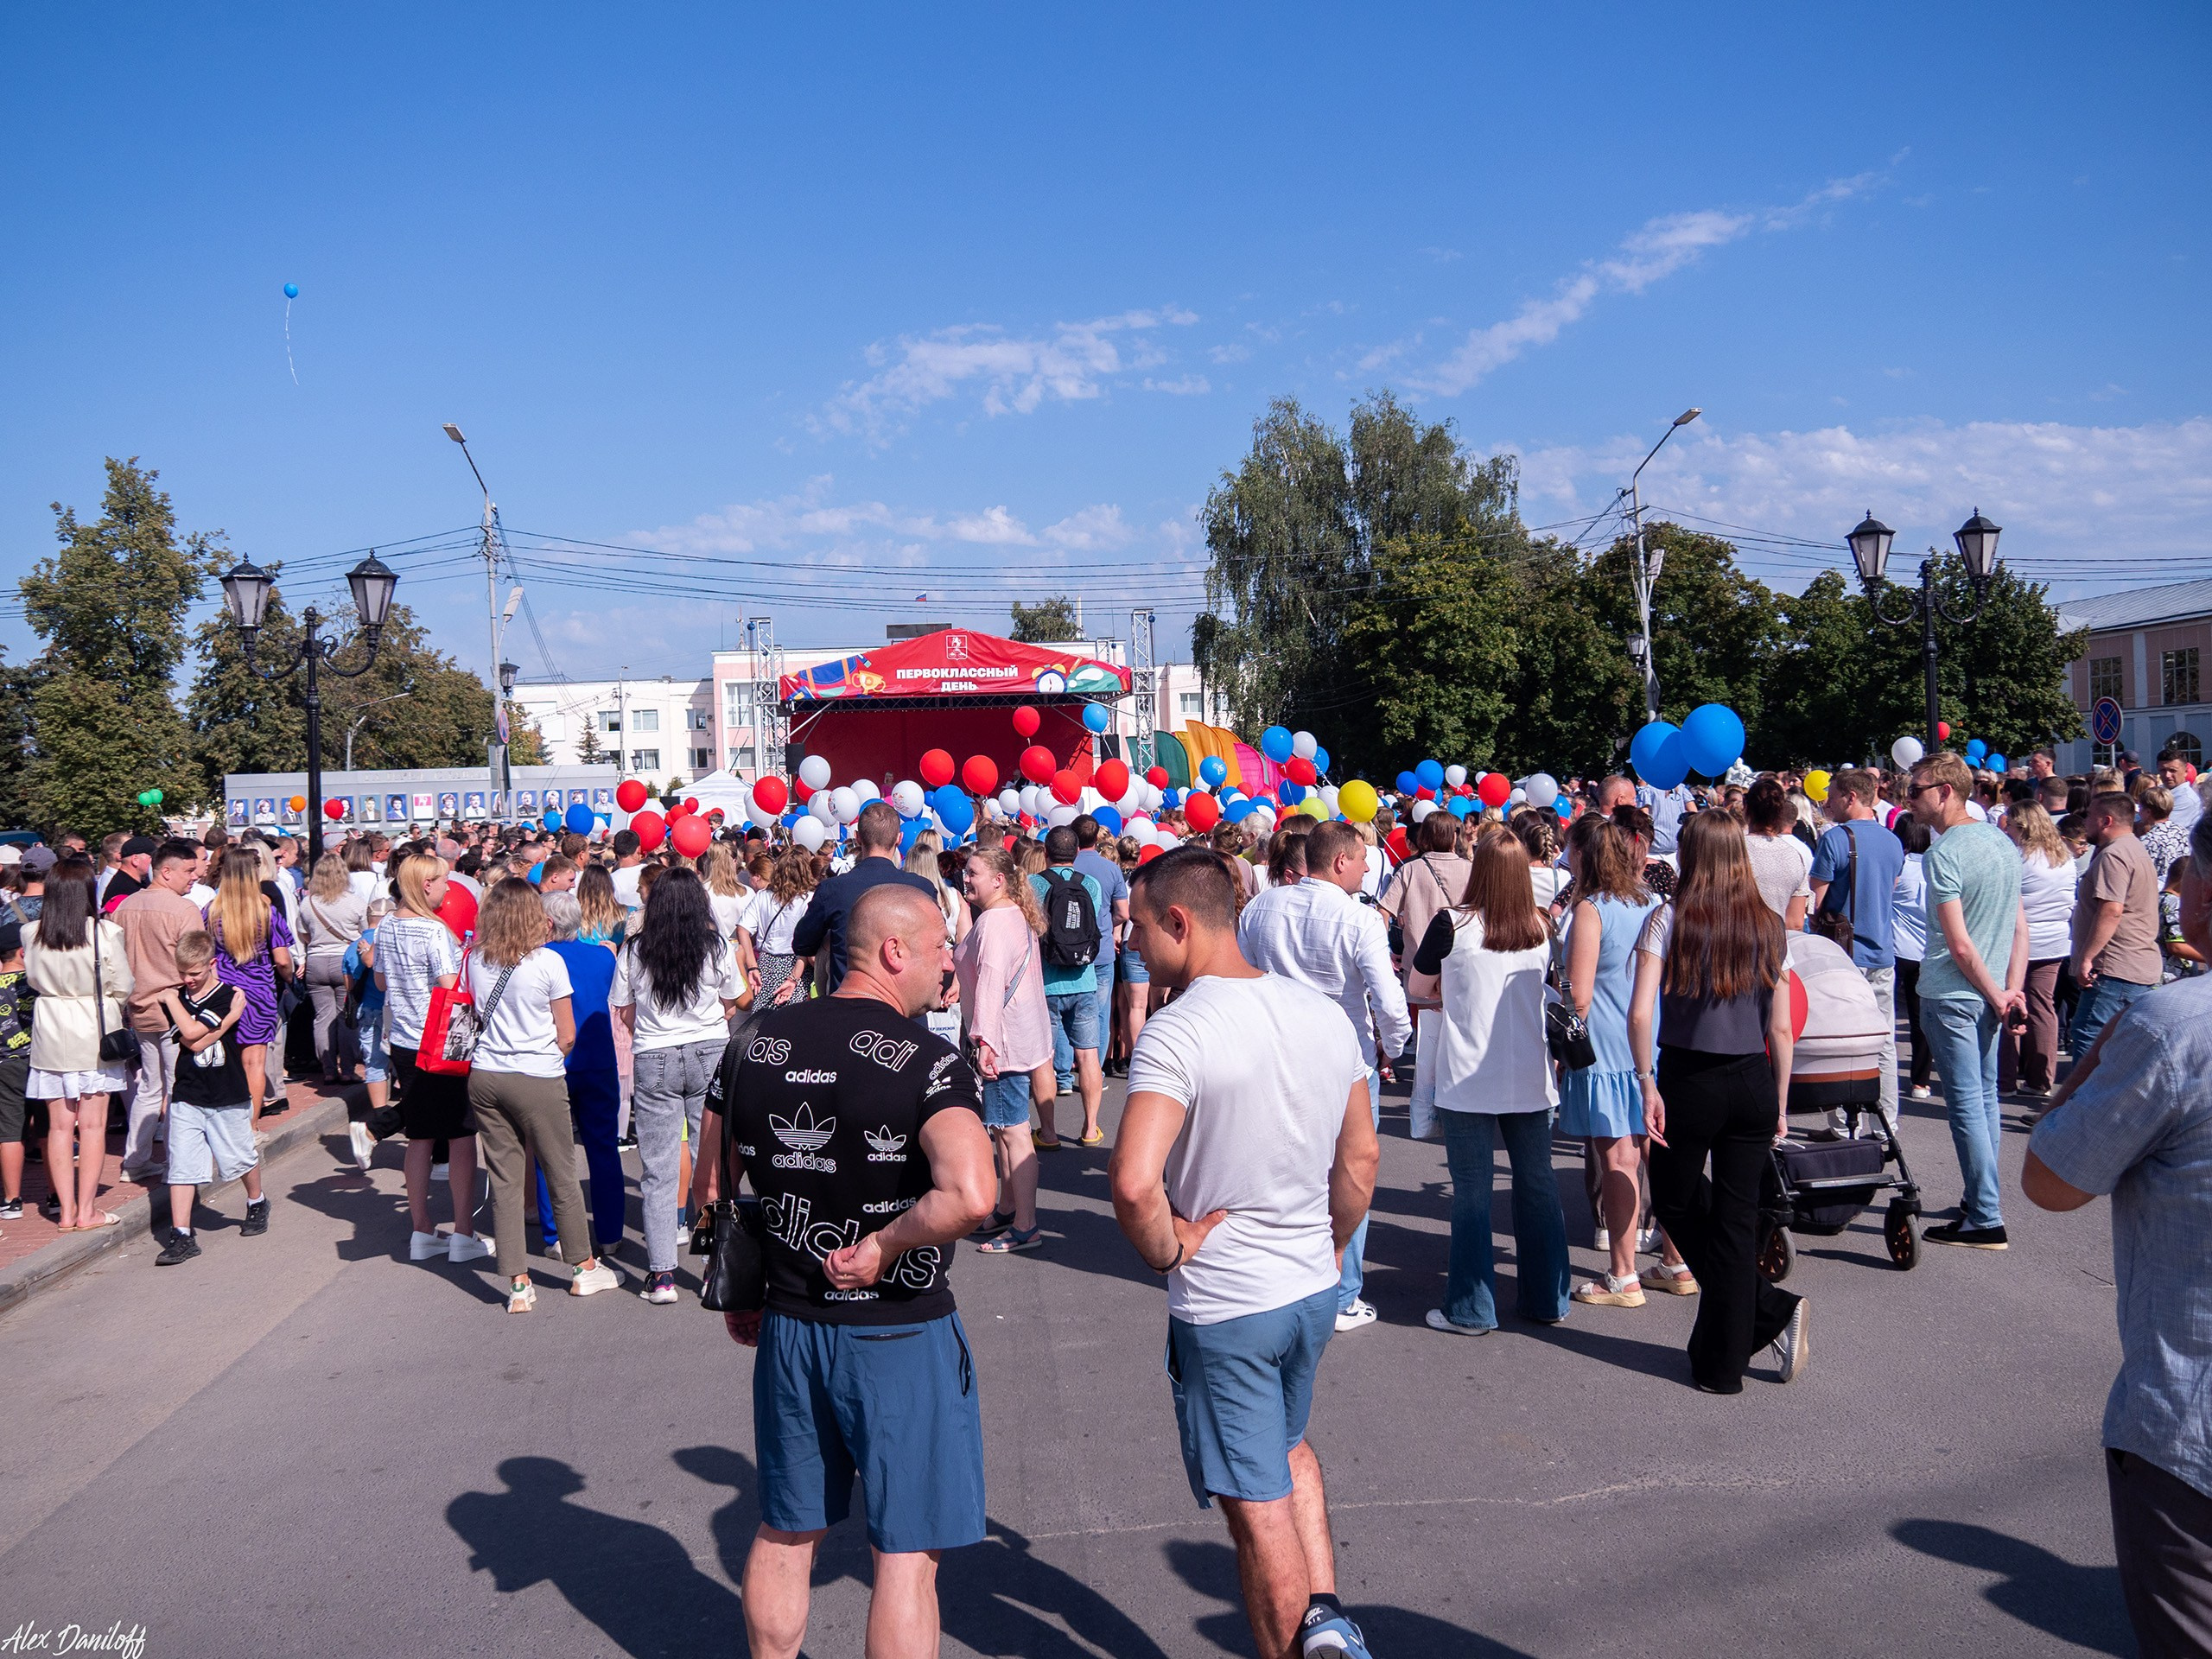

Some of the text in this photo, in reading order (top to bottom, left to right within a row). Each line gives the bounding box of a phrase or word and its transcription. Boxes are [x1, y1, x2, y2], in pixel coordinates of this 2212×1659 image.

[896, 664, 1018, 679] ПЕРВОКЛАССНЫЙ
[940, 680, 977, 692] ДЕНЬ
[744, 1031, 791, 1065] as
[929, 1052, 959, 1080] adidas
[785, 1069, 837, 1084] adidas
[736, 1142, 756, 1156] das
[772, 1152, 837, 1173] adidas
[868, 1152, 907, 1162] adidas
[862, 1197, 917, 1213] adidas
[824, 1287, 880, 1301] adidas
